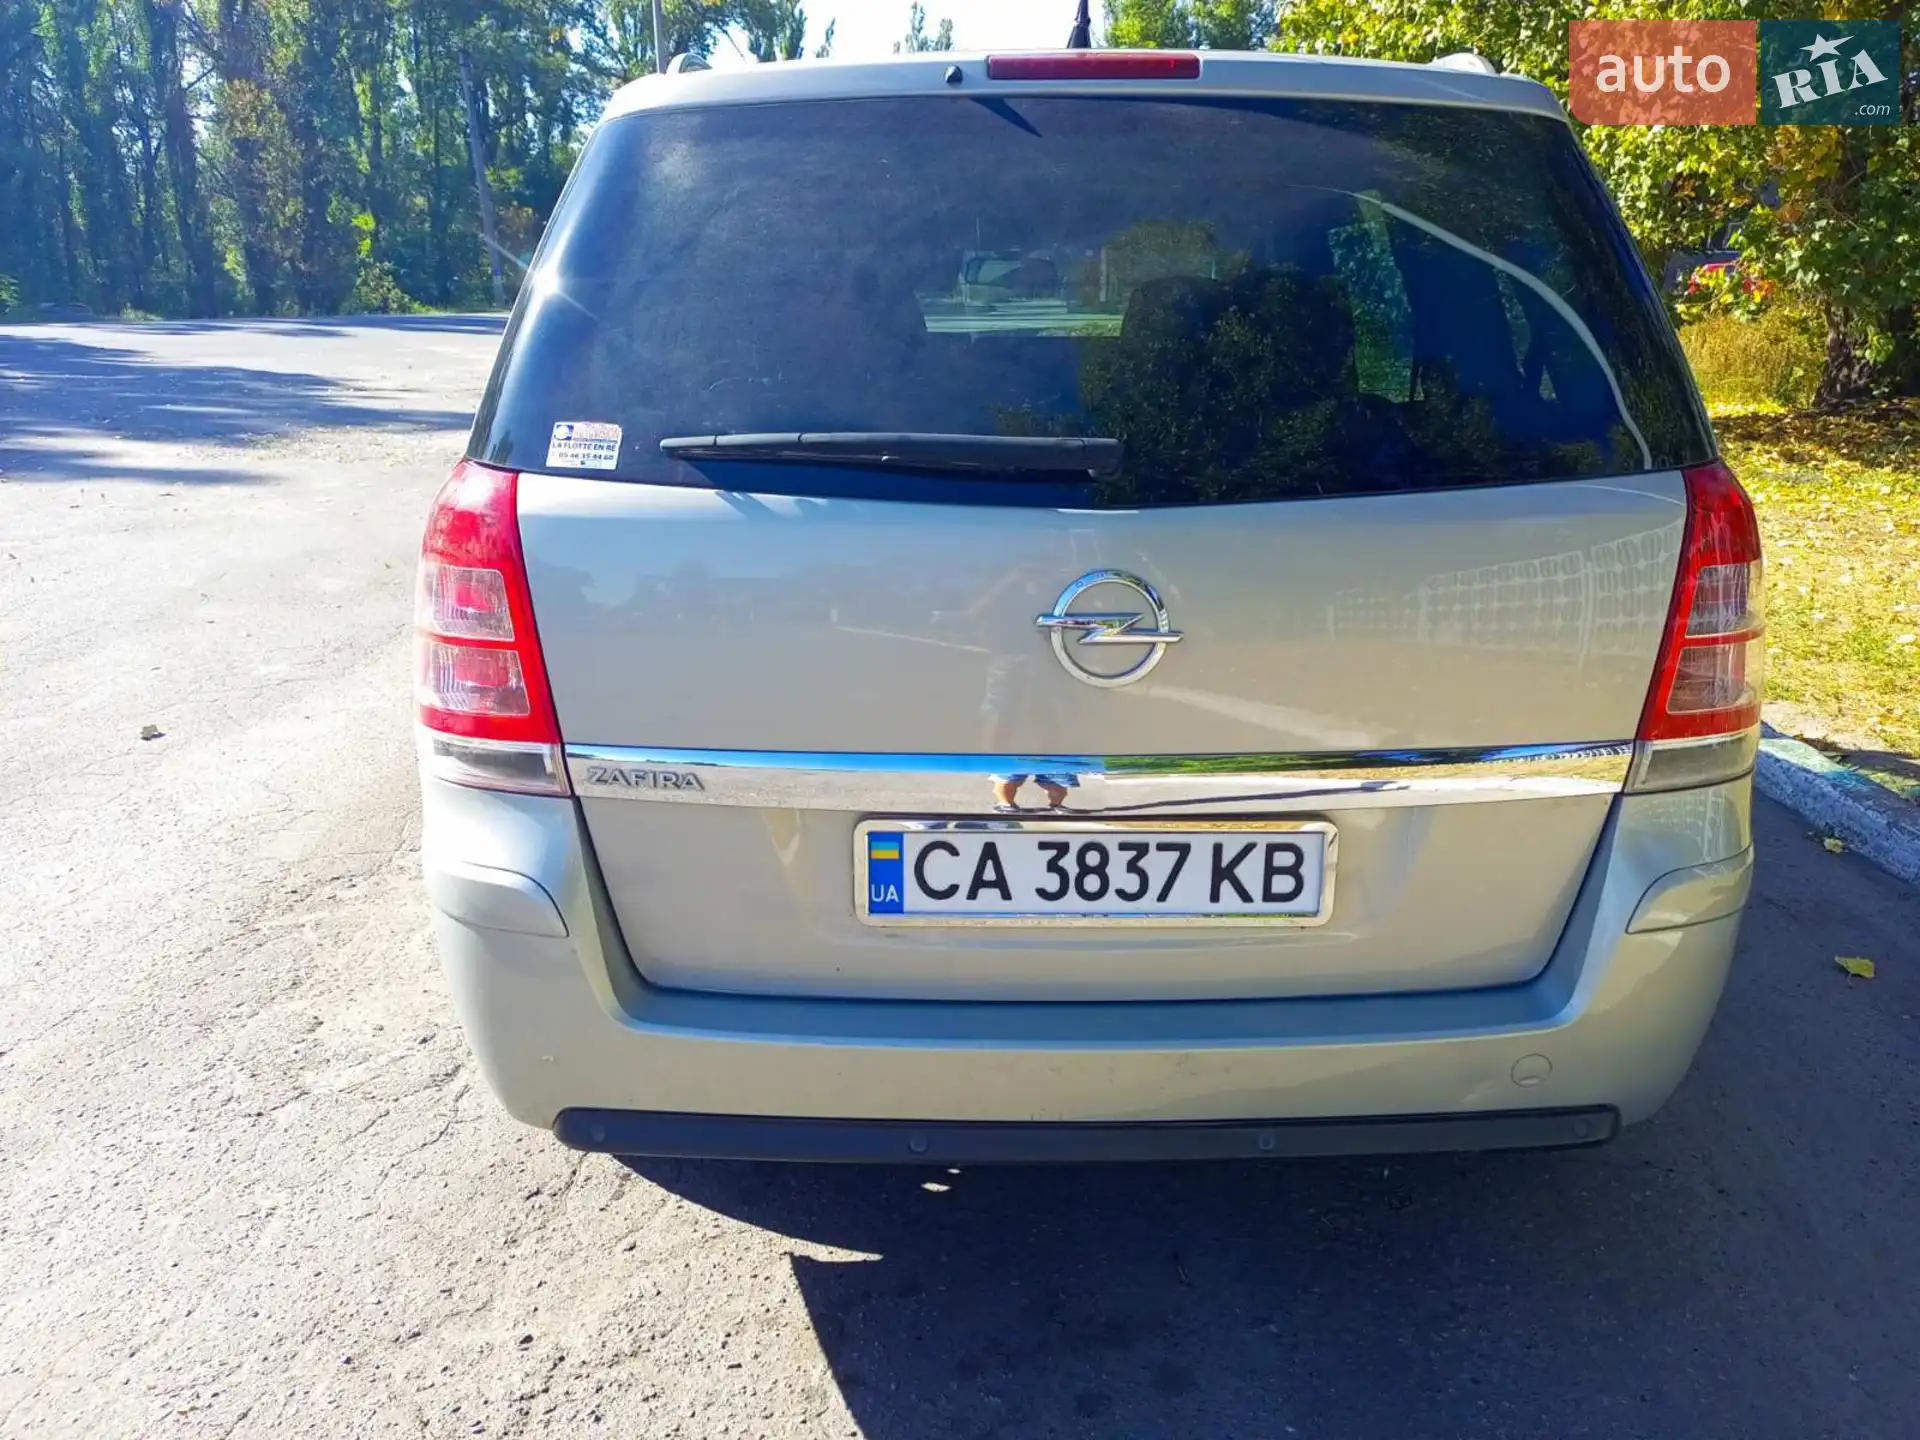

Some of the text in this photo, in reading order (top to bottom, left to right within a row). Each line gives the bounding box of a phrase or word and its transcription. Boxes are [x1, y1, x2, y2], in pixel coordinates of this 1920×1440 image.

[587, 766, 705, 790] ZAFIRA
[914, 840, 1305, 904] CA 3837 KB
[870, 883, 900, 904] UA
